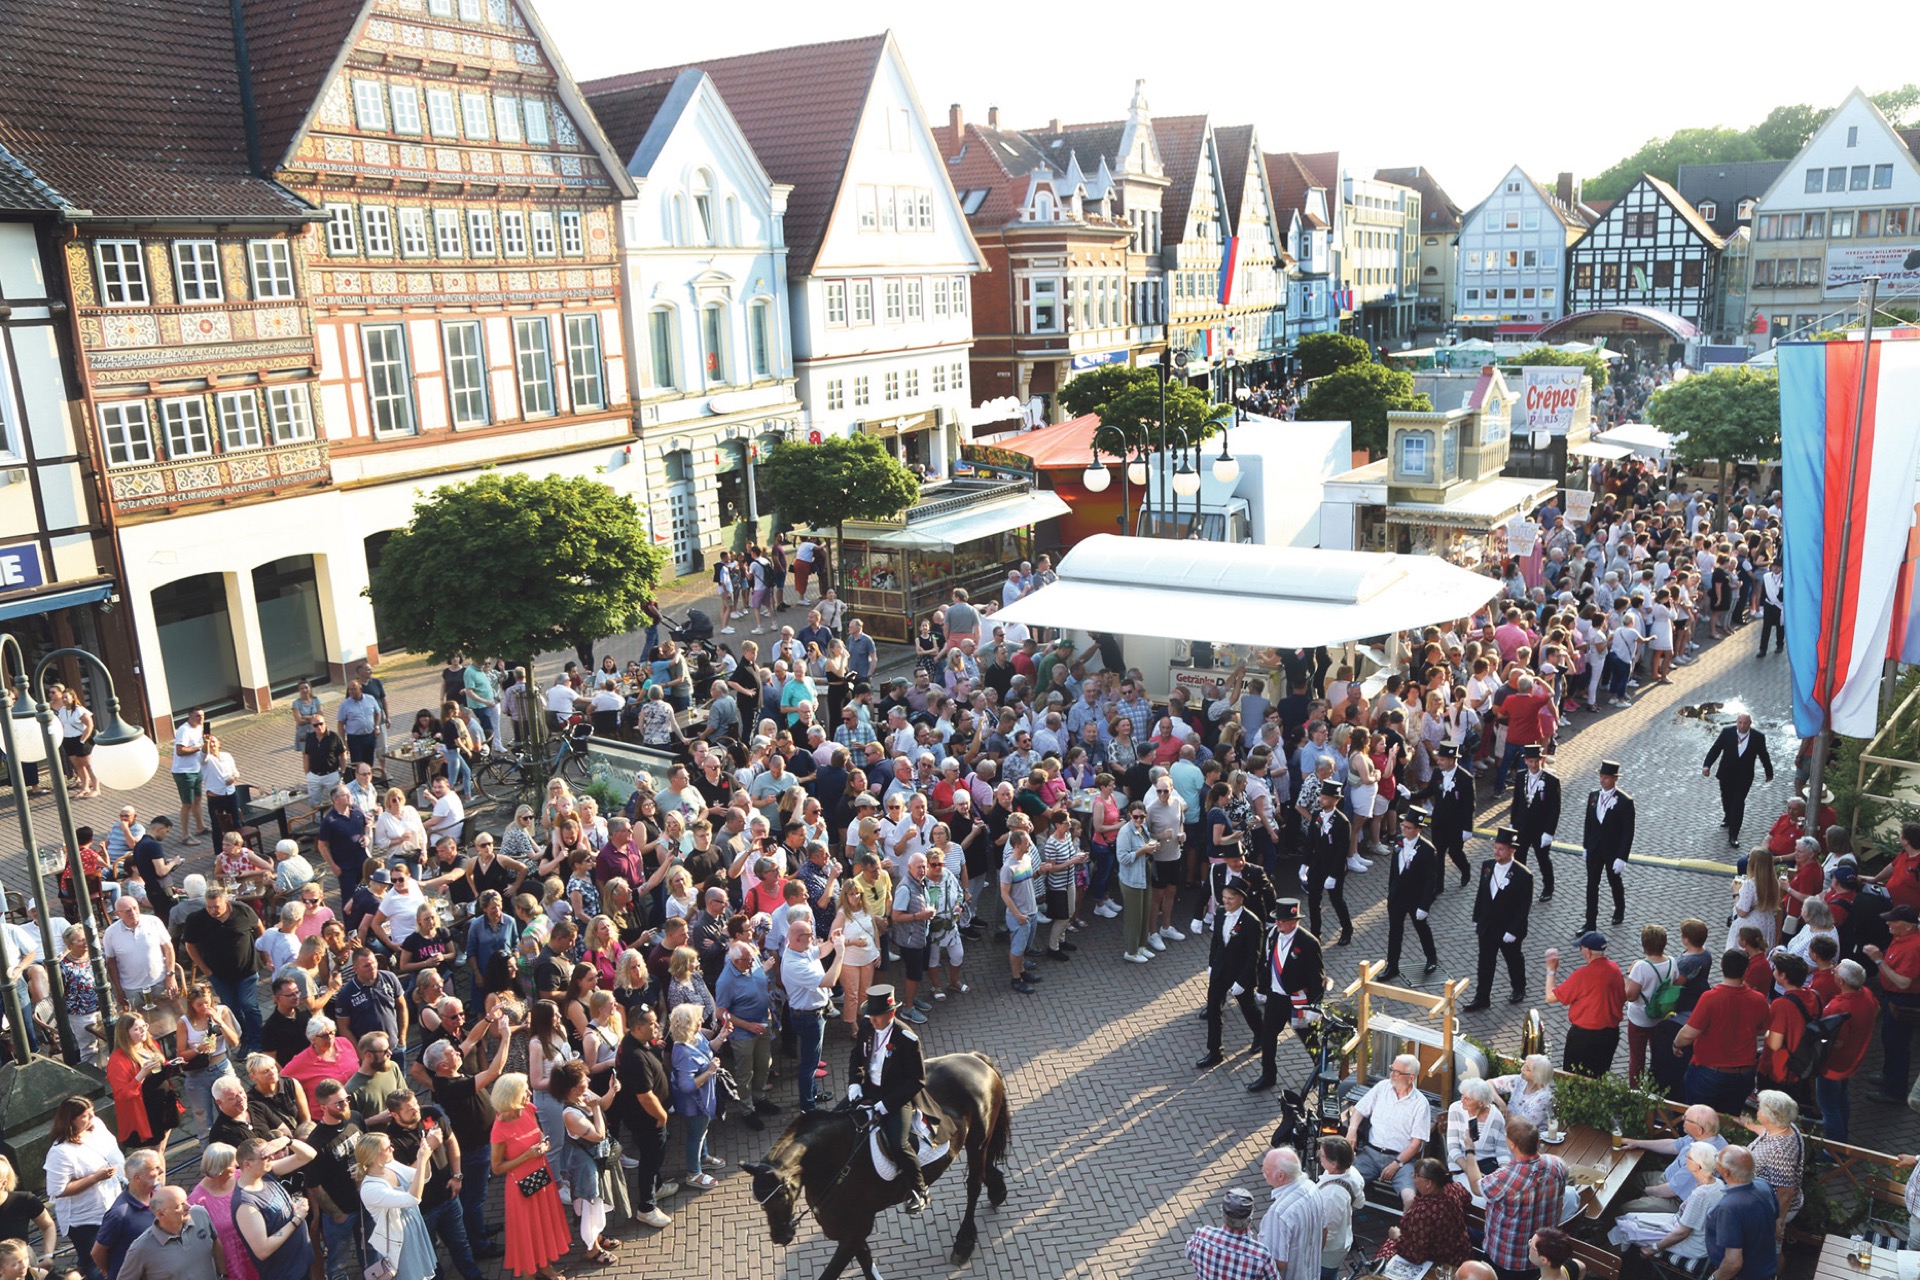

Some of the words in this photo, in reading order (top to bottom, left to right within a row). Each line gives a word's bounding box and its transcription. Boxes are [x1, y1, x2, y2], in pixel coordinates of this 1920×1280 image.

[1526, 384, 1577, 415] Crêpes
[1176, 673, 1215, 685] Getränke
[418, 943, 446, 958] MOIN
